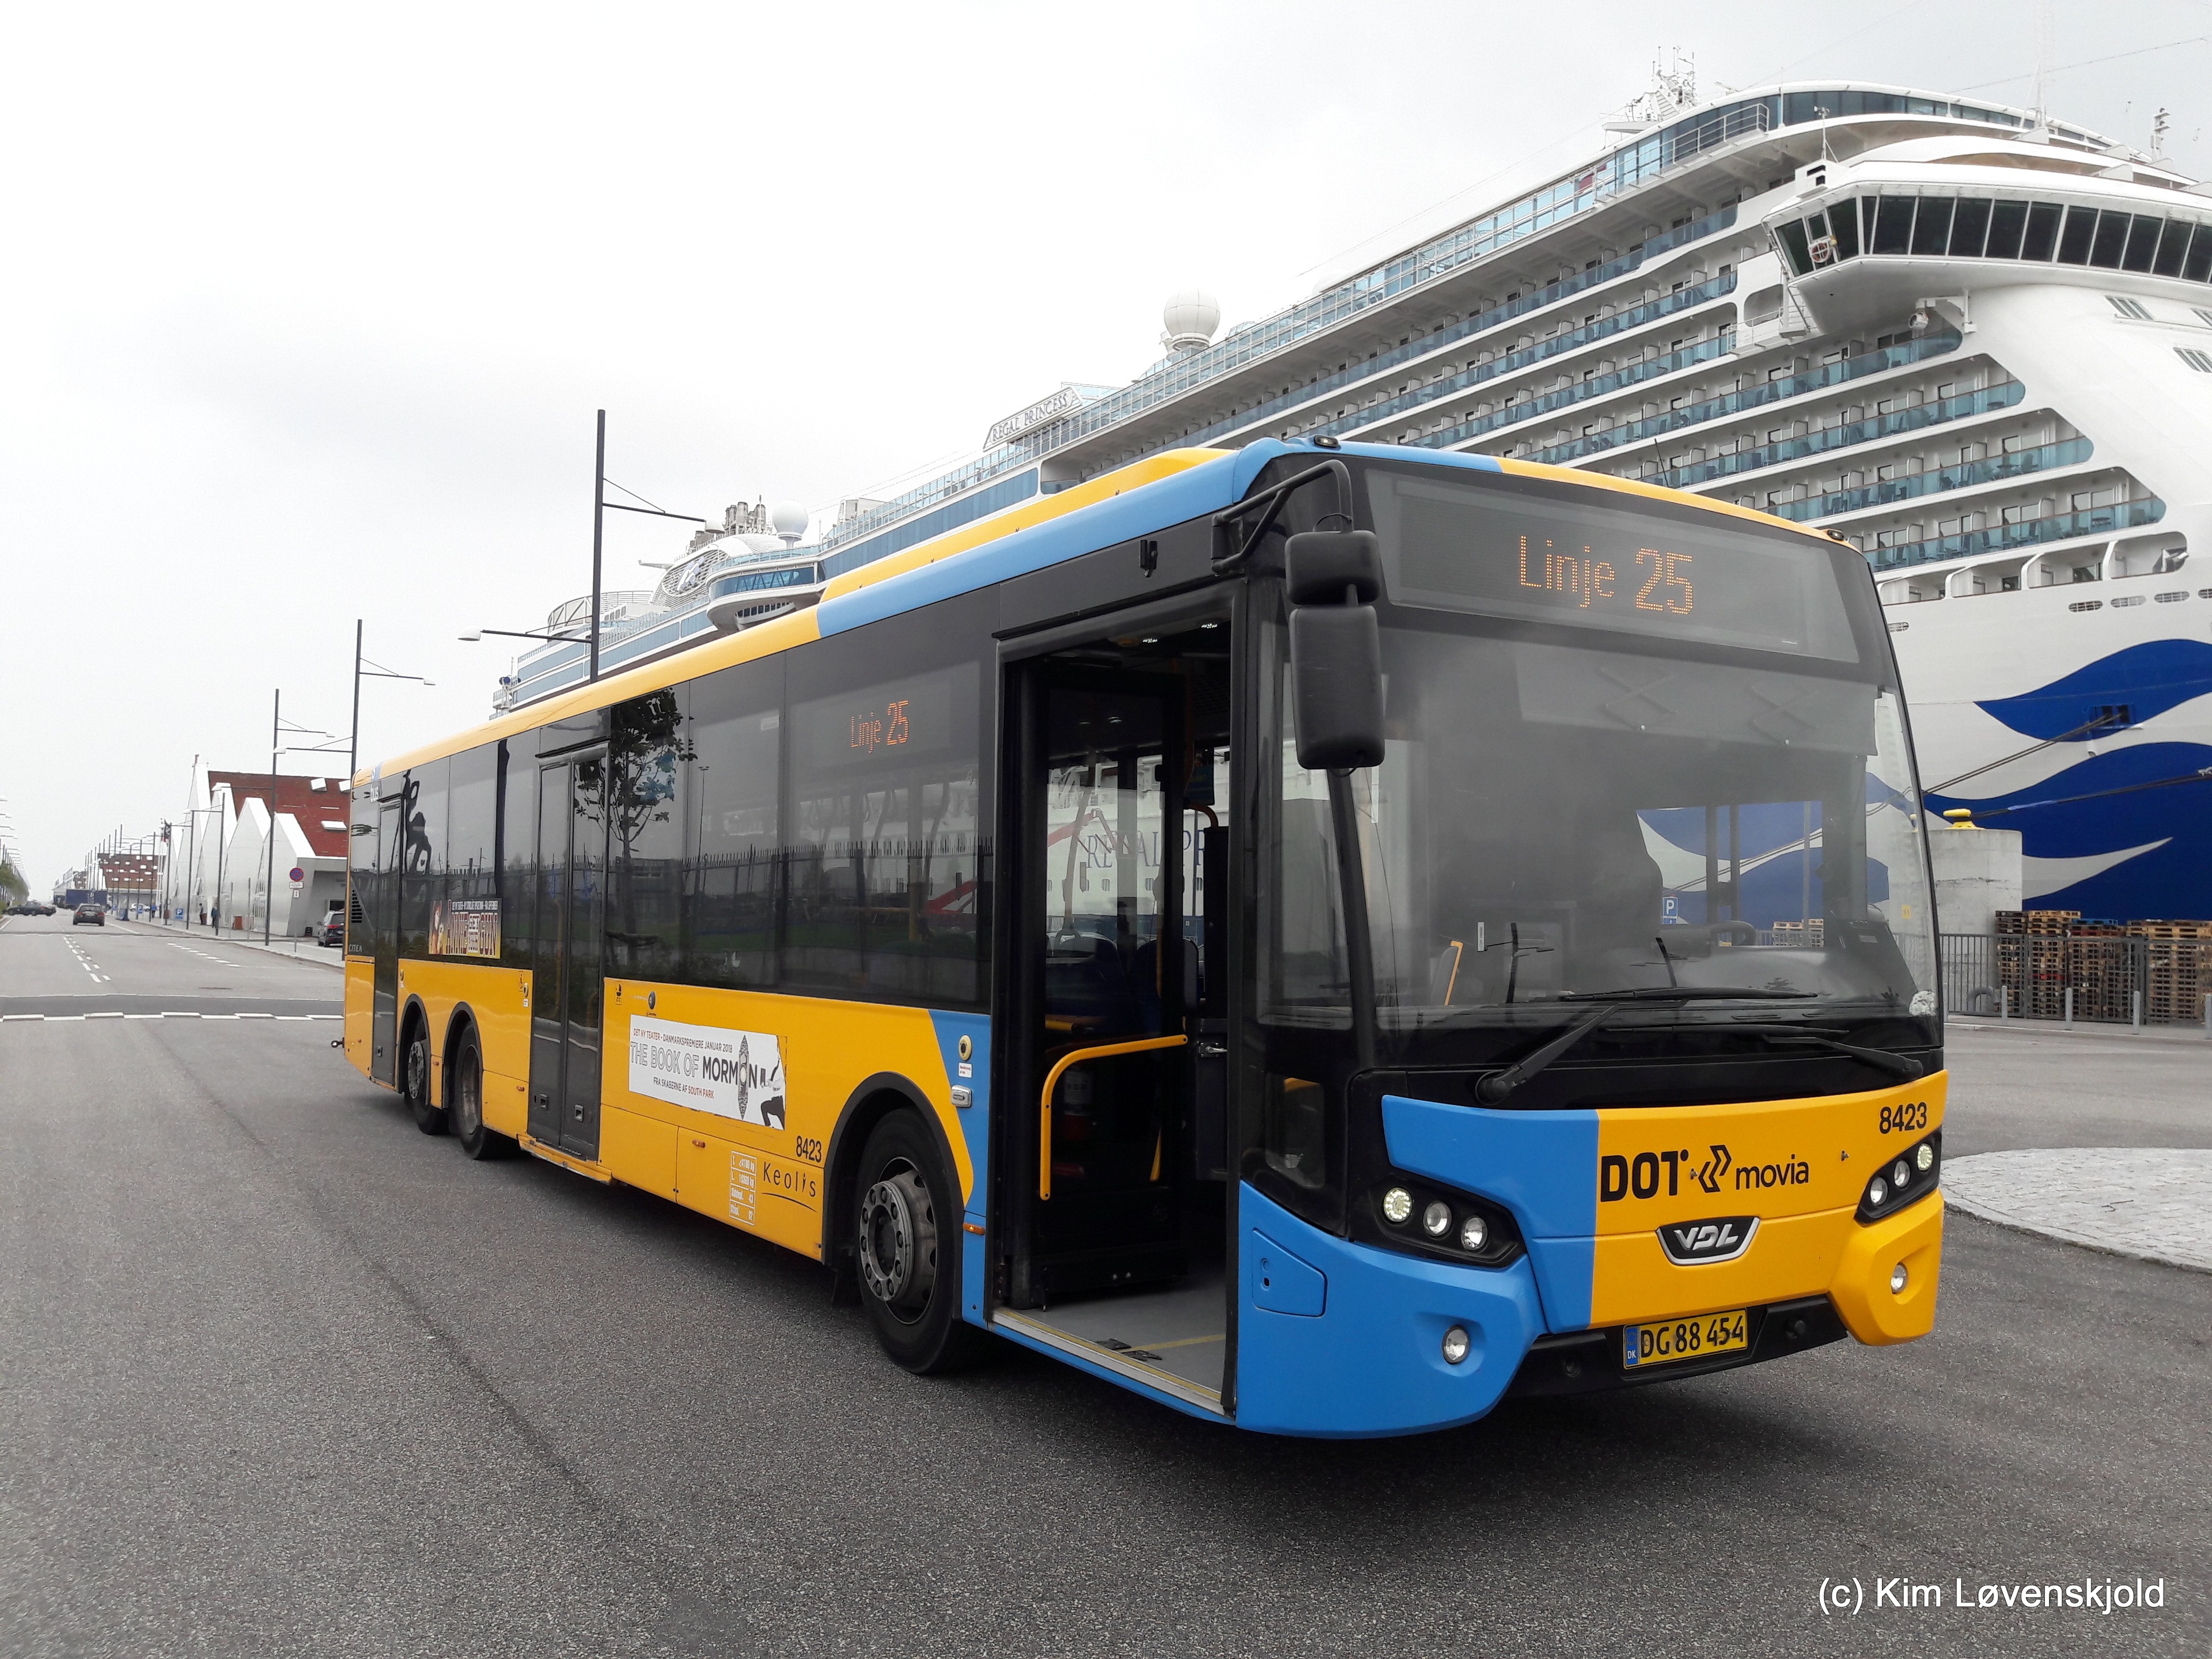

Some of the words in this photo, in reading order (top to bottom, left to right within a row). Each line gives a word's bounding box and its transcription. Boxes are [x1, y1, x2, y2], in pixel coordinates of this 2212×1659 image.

[992, 417, 1020, 441] REGAL
[1024, 393, 1068, 426] PRINCESS
[1520, 535, 1615, 608] Linje
[1635, 547, 1694, 615] 25
[850, 711, 881, 753] Linje
[887, 700, 909, 745] 25
[1086, 830, 1160, 868] REAL
[1666, 900, 1675, 915] P
[630, 1041, 648, 1066] THE
[651, 1046, 681, 1074] BOOK
[683, 1053, 699, 1078] OF
[641, 1029, 646, 1037] NY
[646, 1031, 660, 1040] TEATER
[663, 1033, 704, 1048] DANMARKSPREMIERE
[704, 1041, 722, 1052] JANUAR
[722, 1043, 733, 1053] 2018
[653, 1077, 661, 1085] FRA
[661, 1078, 681, 1092] SKABERNE
[682, 1084, 688, 1093] AF
[688, 1085, 702, 1097] SOUTH
[702, 1088, 714, 1099] PARK
[1878, 1101, 1927, 1135] 8423
[796, 1135, 822, 1163] 8423
[763, 1161, 816, 1198] Keolis
[1600, 1150, 1679, 1202] DOT
[1735, 1153, 1809, 1191] movia
[1673, 1223, 1739, 1251] VDL
[1627, 1350, 1637, 1359] DK
[1641, 1327, 1670, 1358] DG
[1675, 1321, 1700, 1353] 88
[1706, 1315, 1743, 1346] 454
